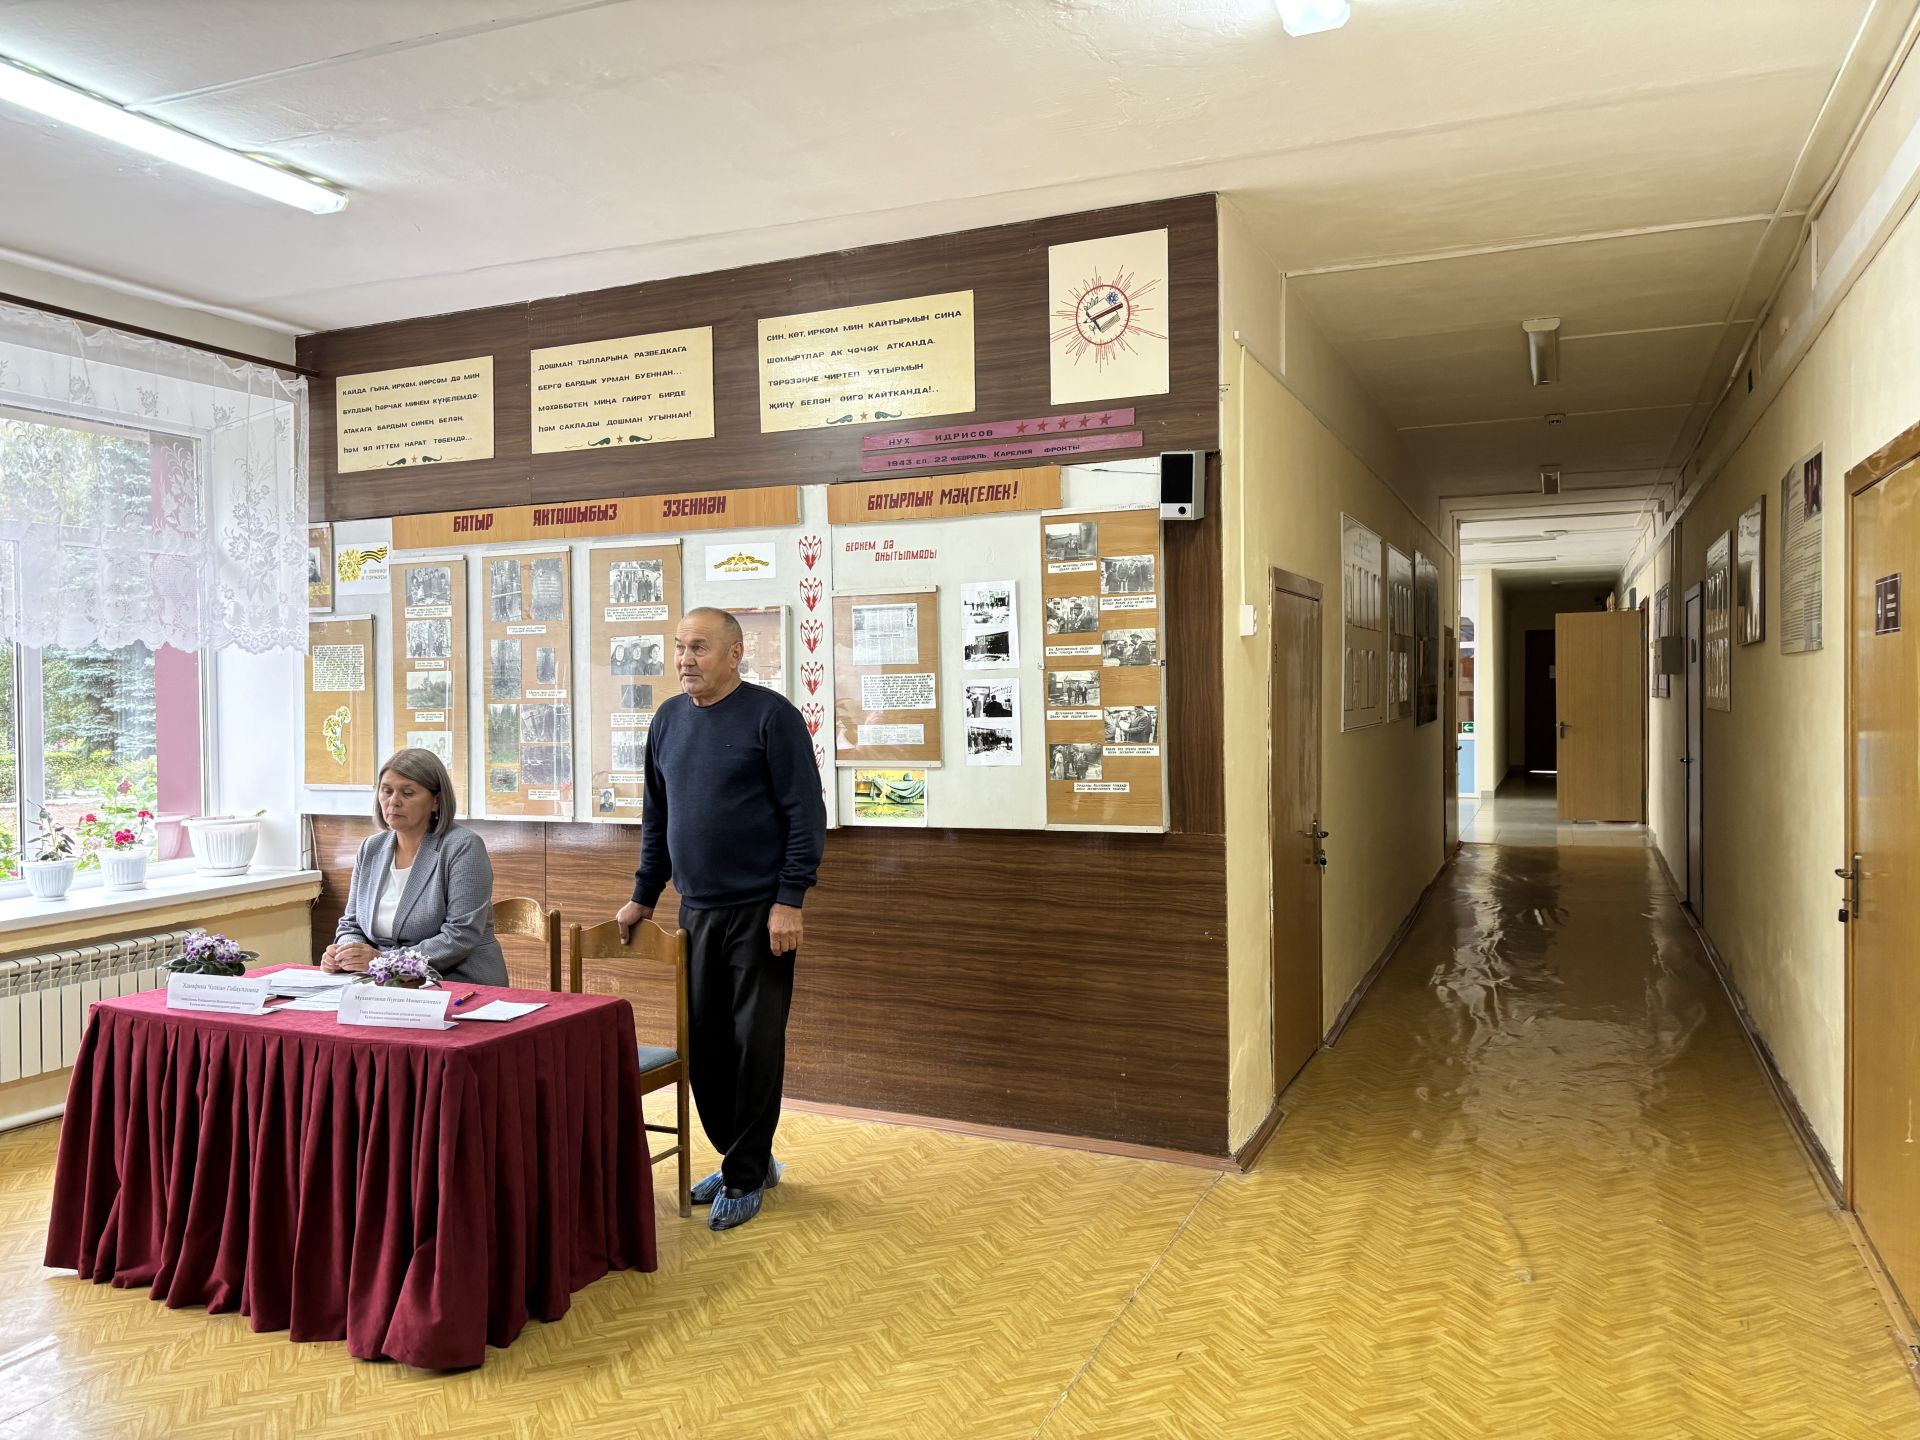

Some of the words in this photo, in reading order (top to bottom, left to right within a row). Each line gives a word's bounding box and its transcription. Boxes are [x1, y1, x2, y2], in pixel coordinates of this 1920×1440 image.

[935, 311, 961, 319] СИҢА
[538, 361, 572, 370] ДОШМАН
[578, 354, 628, 365] ТЫЛЛАРЫНА
[634, 346, 687, 358] РАЗВЕДКАГА
[767, 352, 824, 364] ШОМЫРТЛАР
[824, 371, 859, 380] ЧИРТЕП
[868, 364, 923, 375] УЯТЫРМЫН
[566, 379, 596, 387] БАРДЫК
[601, 375, 629, 383] УРМАН
[343, 406, 372, 414] БУЛДЫҢ
[560, 421, 599, 430] САКЛАДЫ
[606, 417, 642, 426] ДОШМАН
[648, 410, 691, 421] УГЫННАН!
[889, 438, 912, 447] НУХ
[936, 430, 995, 443] ИДРИСОВ
[888, 460, 913, 469] 1943
[1045, 445, 1082, 455] ФРОНТЫ
[868, 491, 933, 510] БАТЫРЛЫК
[940, 481, 1018, 505] МӘҢГЕЛЕК!
[453, 514, 493, 532] БАТЫР
[532, 504, 617, 526] ЯКТАШЫБЫЗ
[846, 541, 875, 551] БЕРКЕМ
[883, 540, 894, 549] ДӘ
[874, 548, 937, 561] ОНЫТЫЛМАДЫ
